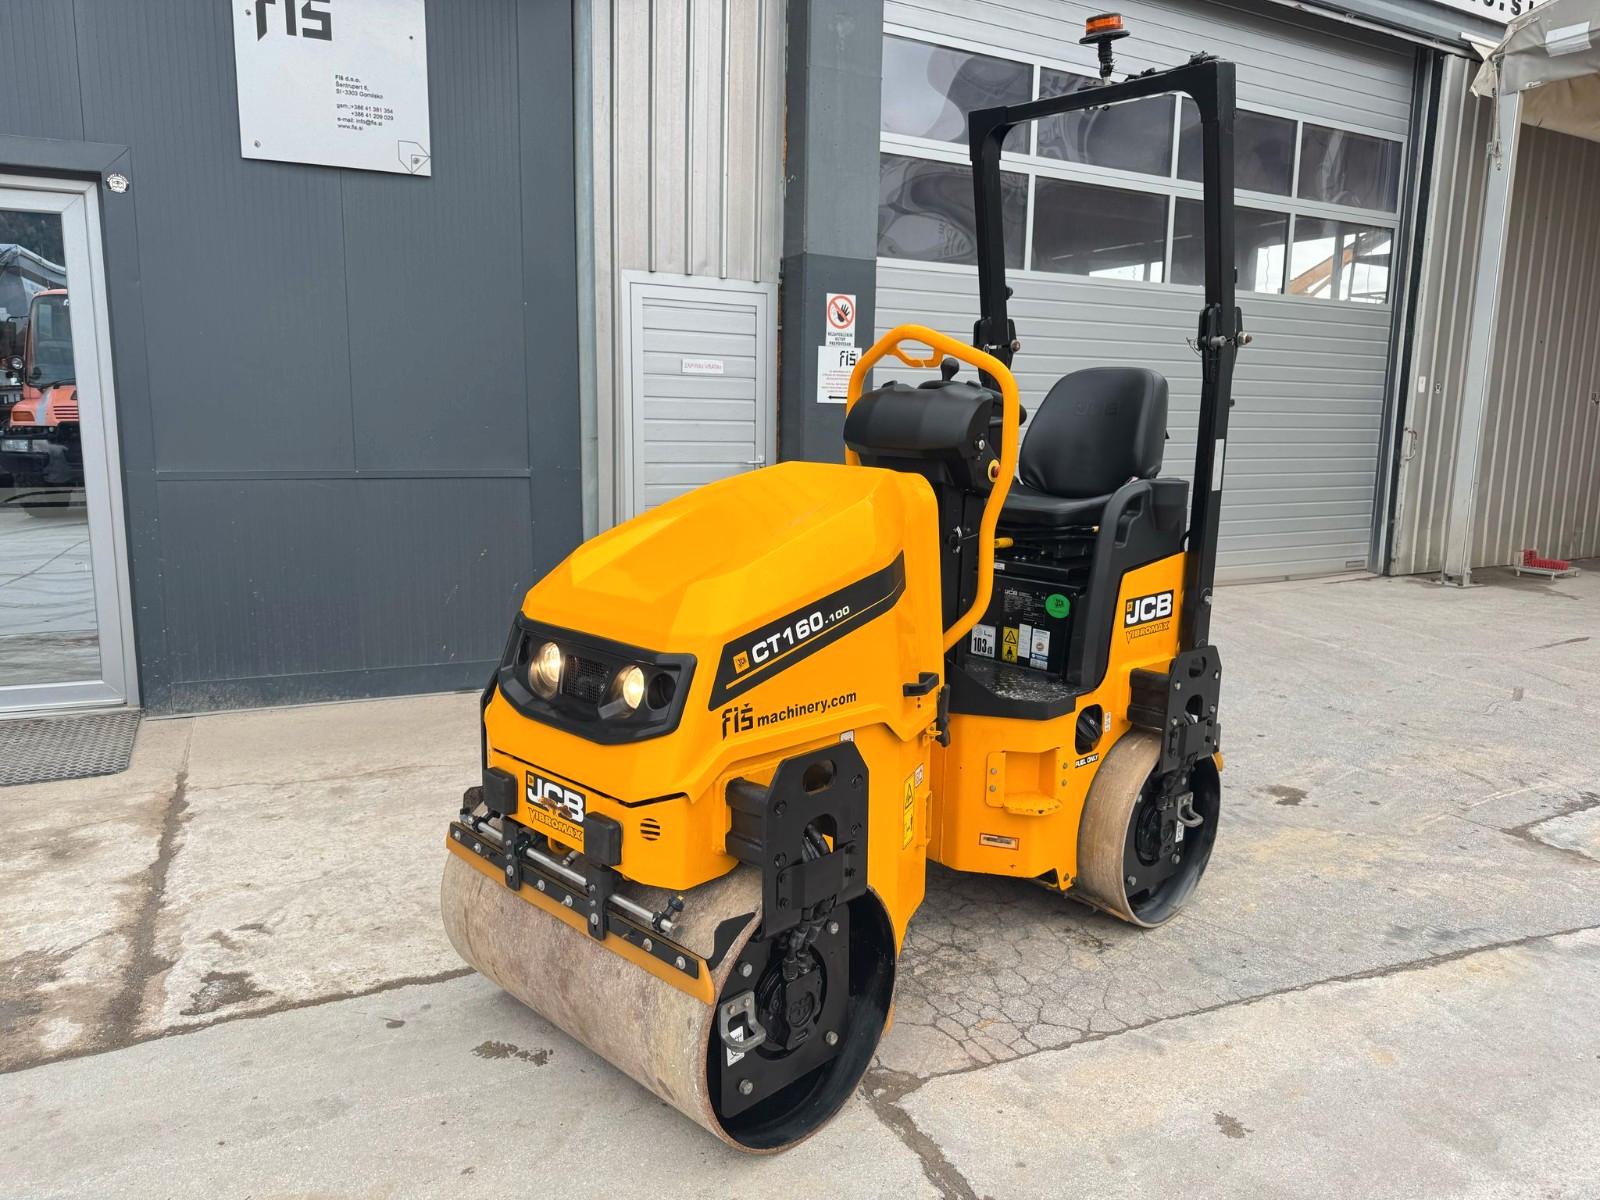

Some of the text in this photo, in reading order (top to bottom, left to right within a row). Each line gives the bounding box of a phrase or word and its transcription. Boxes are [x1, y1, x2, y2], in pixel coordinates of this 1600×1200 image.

[1126, 593, 1172, 624] JCB
[973, 637, 988, 653] 103
[1126, 622, 1170, 644] VIBROMAX
[756, 690, 857, 728] machinery.com
[1075, 755, 1099, 767] FUEL ONLY
[527, 778, 584, 823] JCB
[528, 807, 583, 841] VIBROMAX
